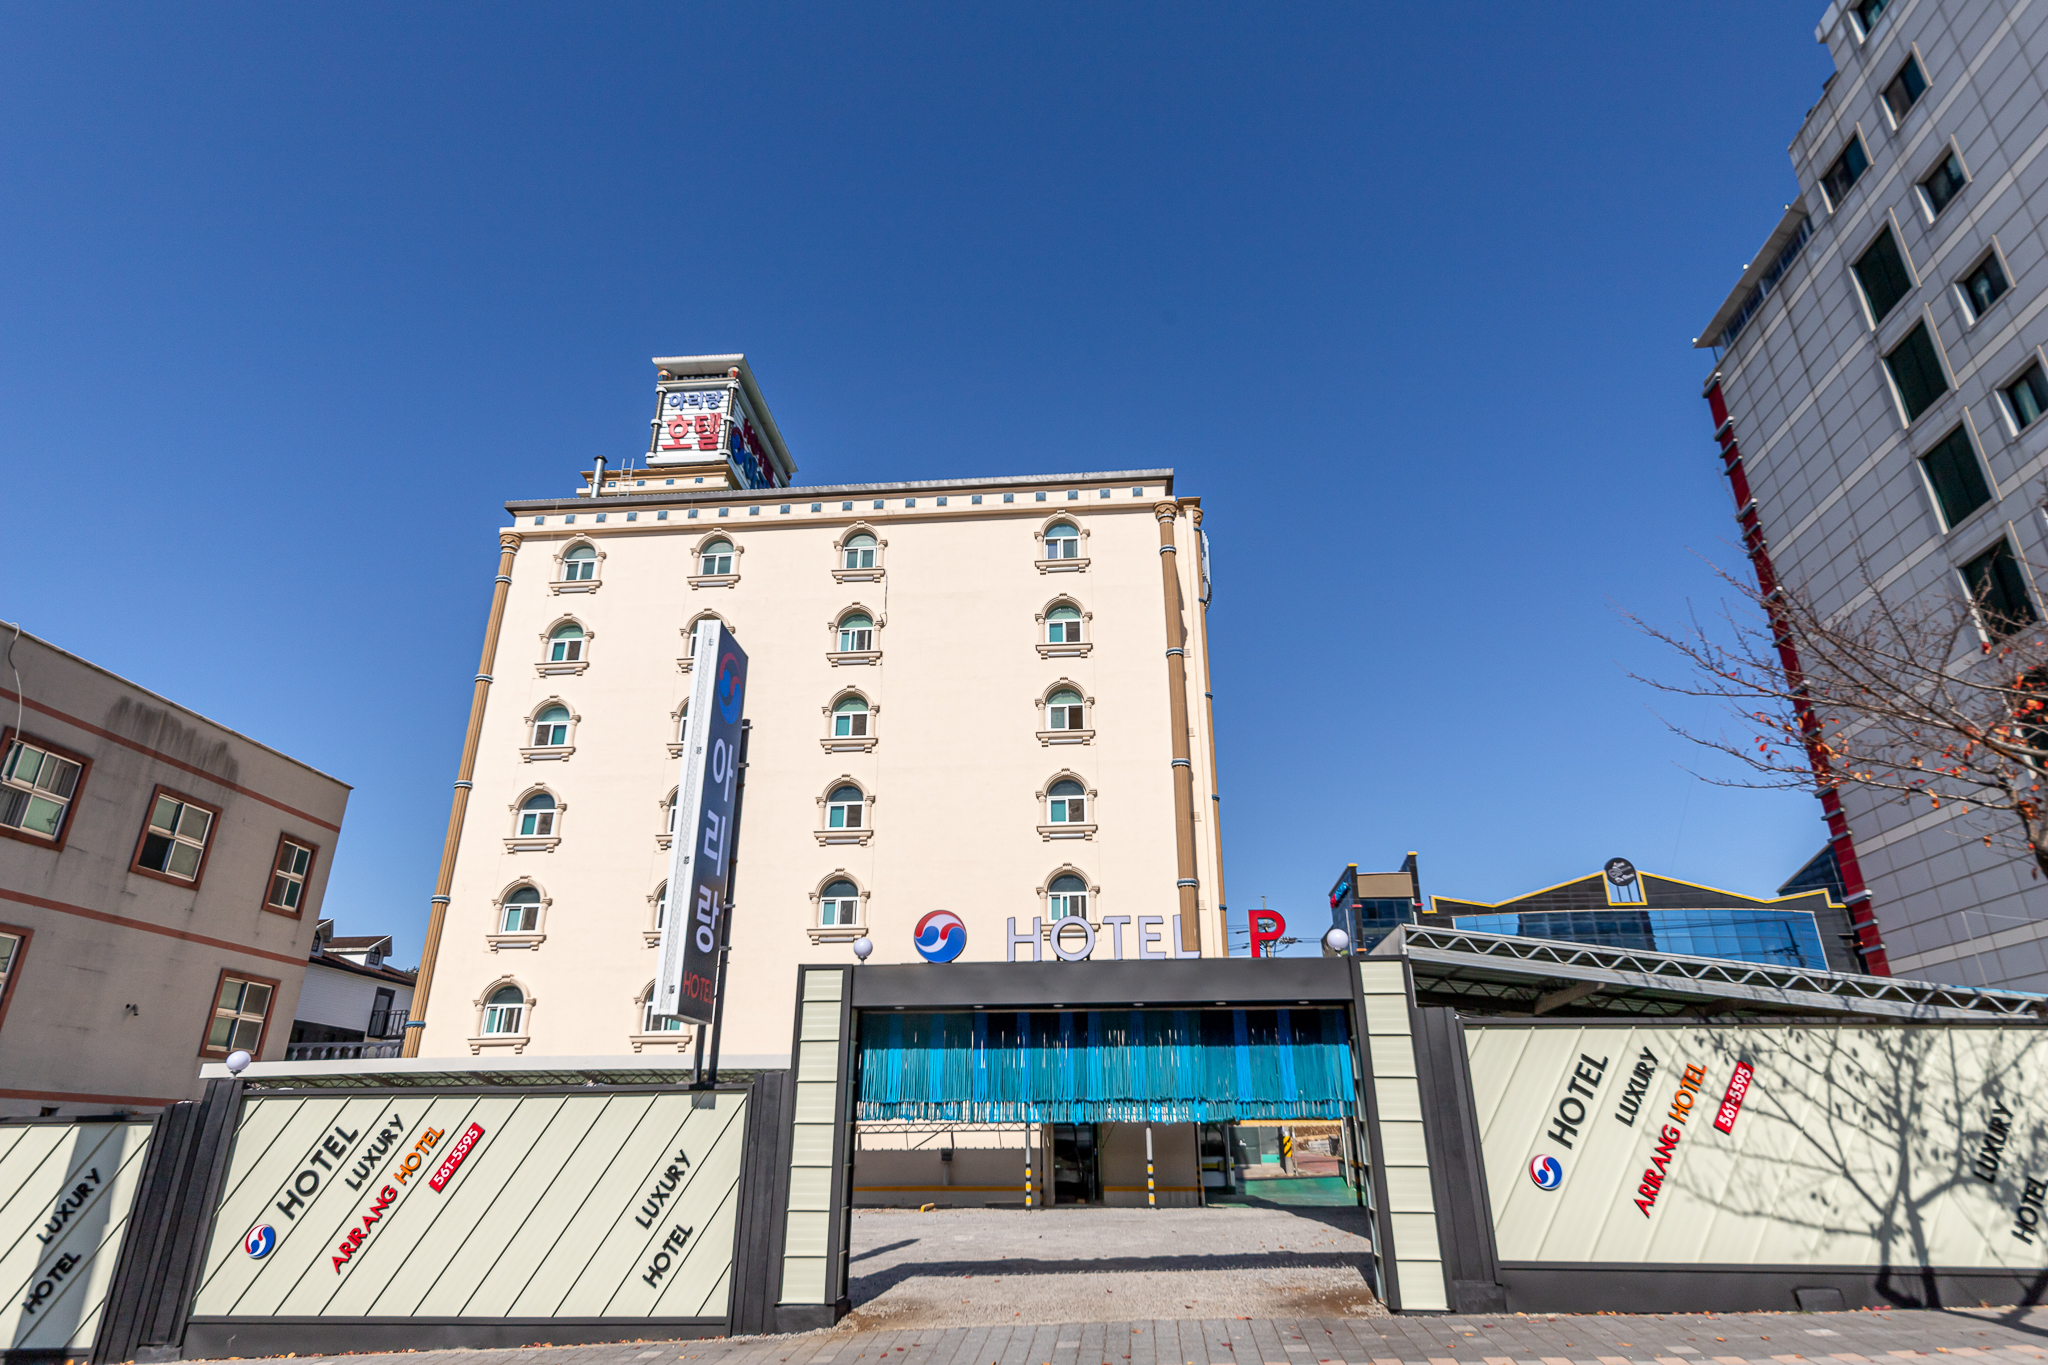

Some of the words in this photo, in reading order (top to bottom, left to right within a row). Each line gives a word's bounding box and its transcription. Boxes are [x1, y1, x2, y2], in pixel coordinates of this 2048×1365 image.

[661, 413, 721, 450] 호텔
[669, 391, 724, 411] 아리랑
[696, 738, 733, 954] 아리랑
[1007, 914, 1201, 963] HOTEL
[1248, 909, 1286, 958] P
[682, 970, 714, 1004] HOTEL
[1547, 1053, 1608, 1150] HOTEL
[1615, 1046, 1659, 1127] LUXURY
[1717, 1066, 1752, 1128] 561-5595
[276, 1126, 359, 1221] HOTEL
[345, 1113, 404, 1191] LUXURY
[433, 1128, 478, 1187] 561-5595
[1634, 1124, 1681, 1219] ARIRANG
[1668, 1063, 1707, 1125] HOTEL
[1973, 1099, 2014, 1184] LUXURY
[36, 1168, 101, 1245] LUXURY
[332, 1184, 397, 1274] ARIRANG
[393, 1127, 445, 1186] HOTEL
[635, 1149, 691, 1230] LUXURY
[2011, 1176, 2048, 1246] HOTEL
[22, 1252, 82, 1315] HOTEL
[642, 1224, 694, 1290] HOTEL
